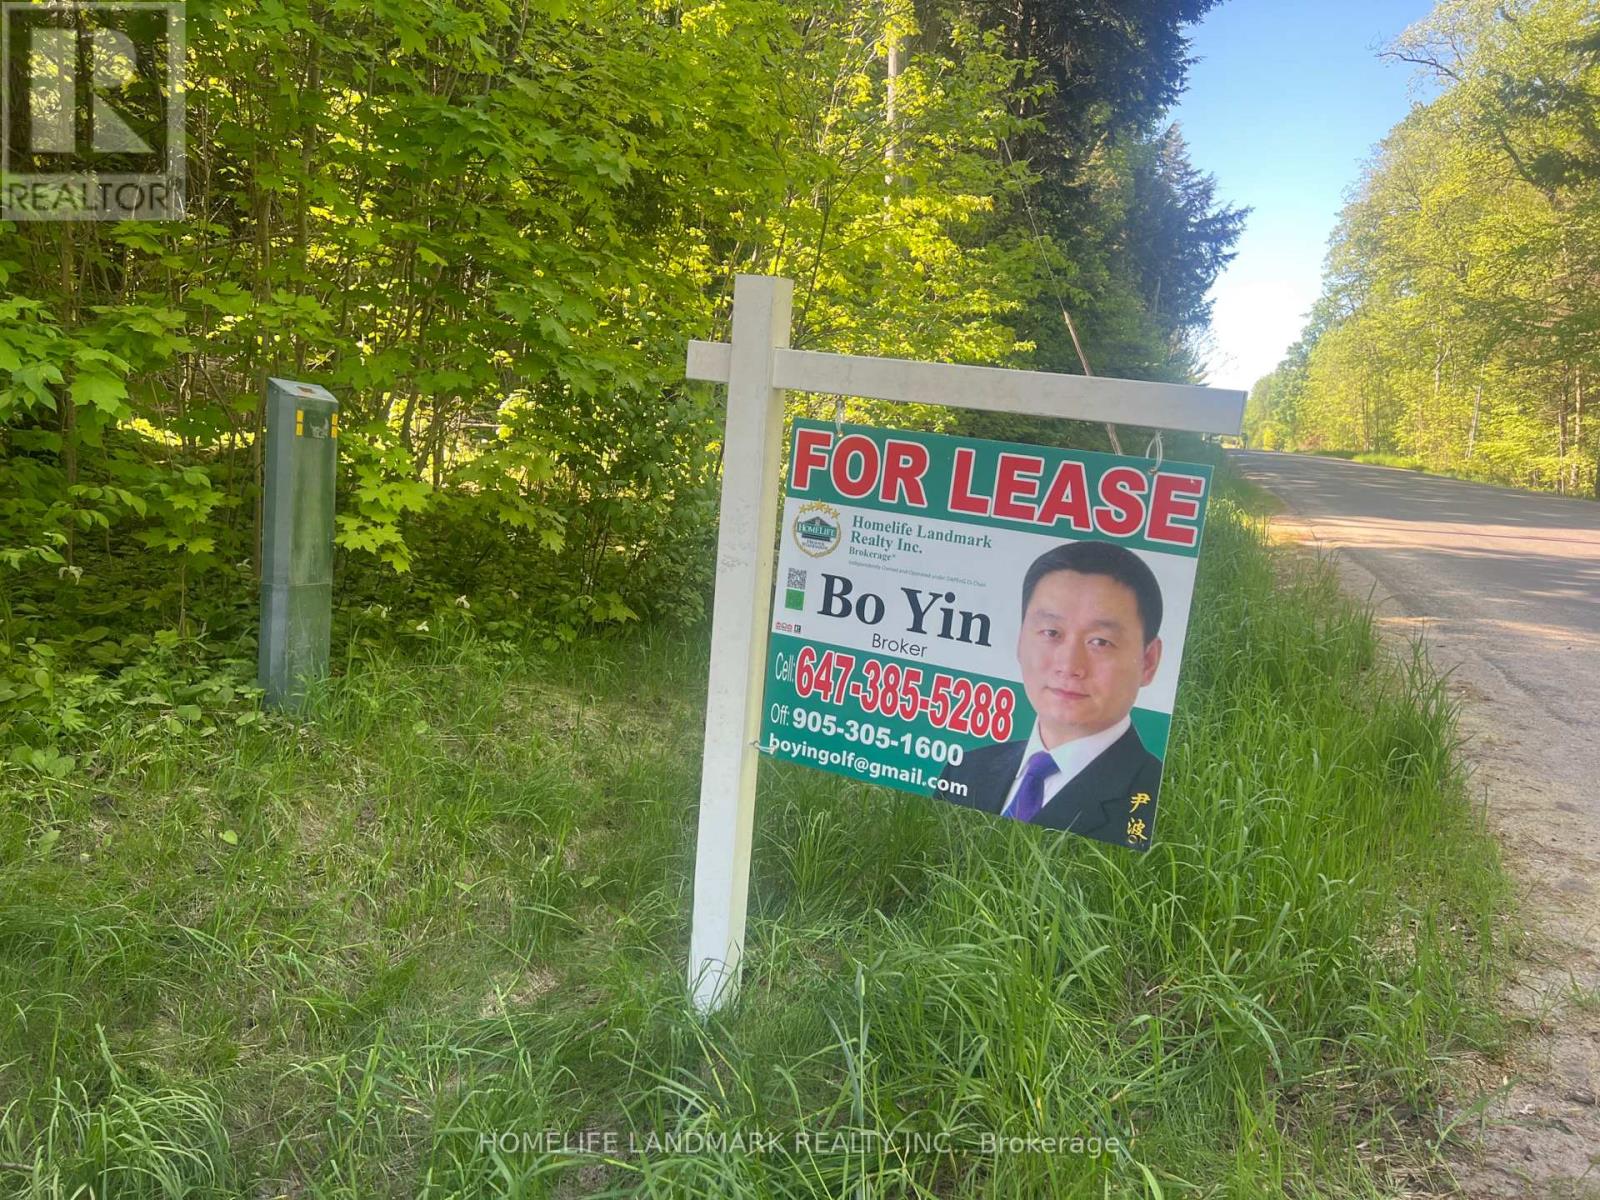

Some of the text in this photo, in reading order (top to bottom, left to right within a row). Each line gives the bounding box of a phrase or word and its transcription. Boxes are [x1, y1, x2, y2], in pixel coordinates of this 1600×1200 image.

[791, 427, 1206, 548] FOR LEASE
[850, 530, 893, 553] Realty
[897, 538, 923, 554] Inc.
[852, 515, 993, 549] Homelife Landmark
[817, 572, 992, 647] Bo Yin
[872, 633, 928, 657] Broker
[775, 645, 1015, 743] Cell: 647-385-5288
[769, 732, 968, 797] boyingolf@gmail.com
[770, 703, 964, 767] Off: 905-305-1600
